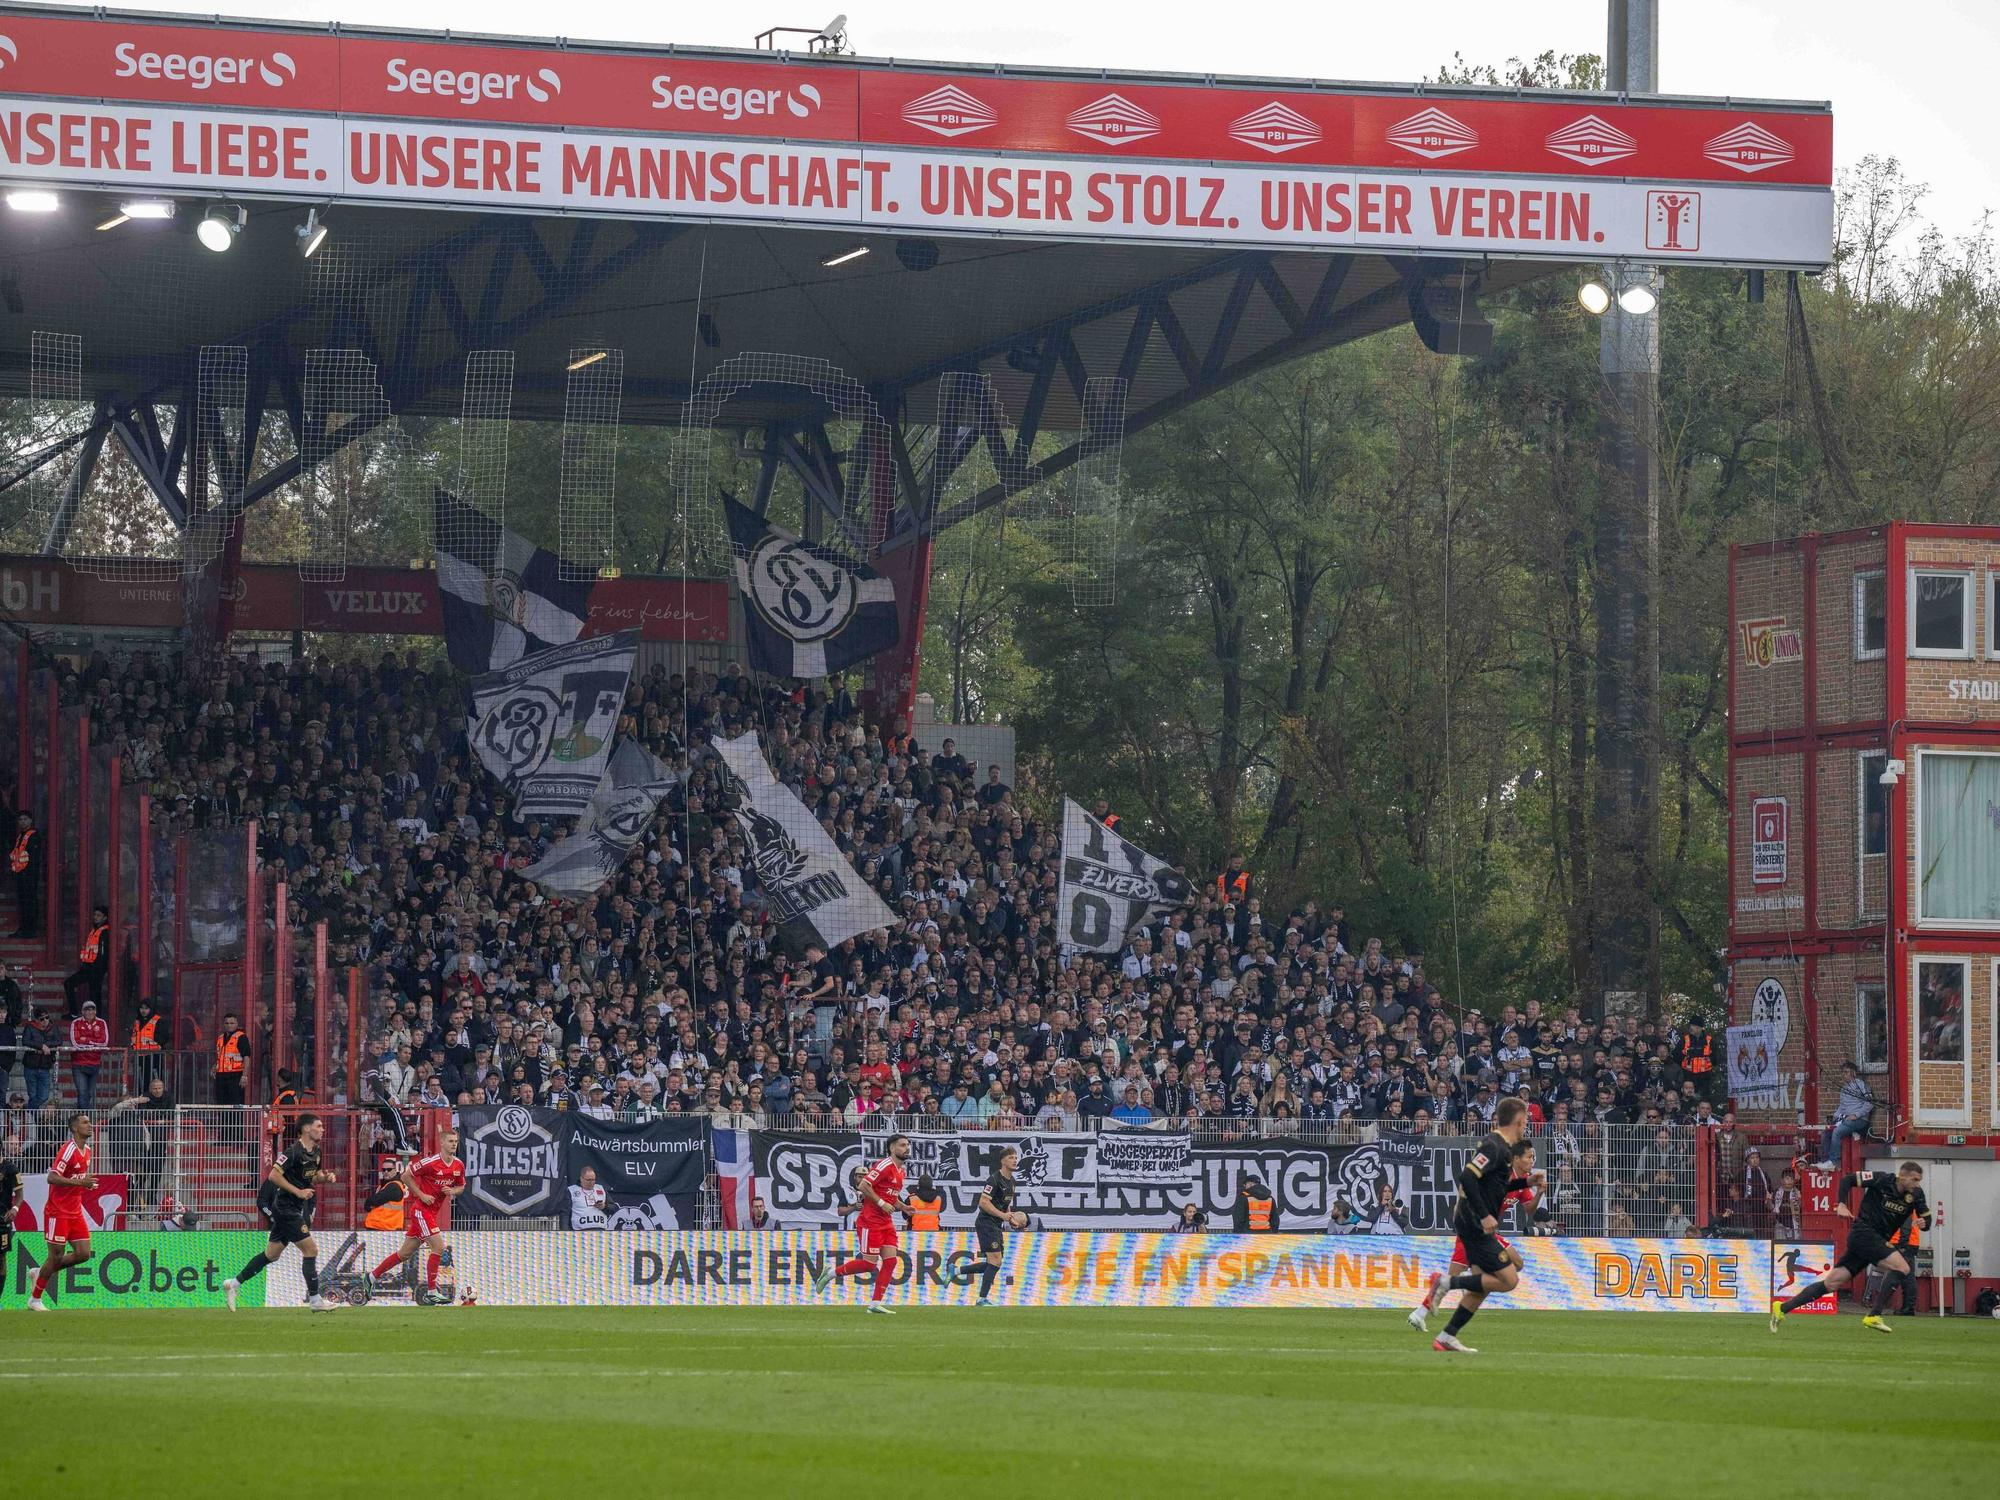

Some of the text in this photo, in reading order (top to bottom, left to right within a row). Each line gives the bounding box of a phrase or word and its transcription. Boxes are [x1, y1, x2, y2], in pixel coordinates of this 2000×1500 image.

[115, 42, 253, 89] Seeger
[386, 58, 520, 104] Seeger
[651, 75, 781, 120] Seeger
[939, 113, 959, 124] PBI
[1104, 123, 1123, 133] PBI
[1266, 131, 1285, 140] PBI
[1423, 136, 1442, 146] PBI
[1582, 143, 1600, 153] PBI
[1740, 150, 1758, 160] PBI
[171, 121, 327, 182] LIEBE.
[350, 131, 541, 193] UNSERE
[563, 144, 899, 213] MANNSCHAFT.
[920, 164, 1072, 222] UNSER
[1087, 175, 1239, 229] STOLZ.
[1260, 179, 1413, 235] UNSER
[1429, 186, 1605, 243] VEREIN.
[325, 590, 424, 616] VELUX
[1949, 679, 1999, 701] STADI
[571, 1130, 706, 1153] Auswärtsbummler
[1381, 1138, 1424, 1157] Theley
[465, 1138, 559, 1179] BLIESEN
[1103, 1143, 1187, 1160] AUSGESPERRTE
[625, 1162, 657, 1176] ELV
[490, 1178, 532, 1187] ELV FREUNDE
[1808, 1172, 1832, 1188] Tor
[1812, 1195, 1830, 1212] 14
[579, 1215, 605, 1226] CLUB
[633, 1250, 752, 1285] DARE
[1047, 1251, 1118, 1286] SIE
[1595, 1253, 1738, 1299] DARE
